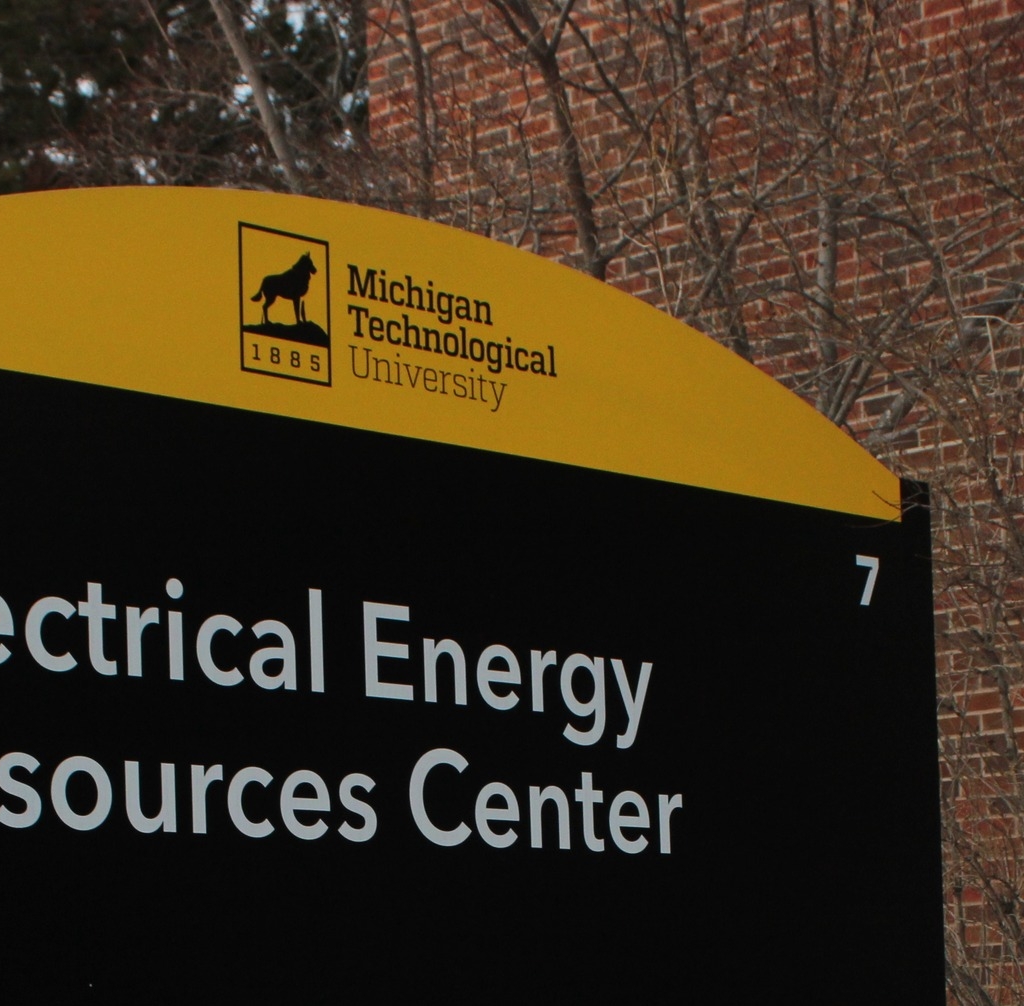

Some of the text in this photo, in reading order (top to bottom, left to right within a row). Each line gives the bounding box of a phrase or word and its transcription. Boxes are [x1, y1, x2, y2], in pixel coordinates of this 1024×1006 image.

[346, 263, 494, 327] Michigan
[251, 343, 321, 373] 1885
[347, 303, 558, 378] Technological
[347, 344, 508, 413] University
[855, 554, 880, 606] 7
[362, 600, 654, 750] Energy
[408, 747, 683, 856] Center
